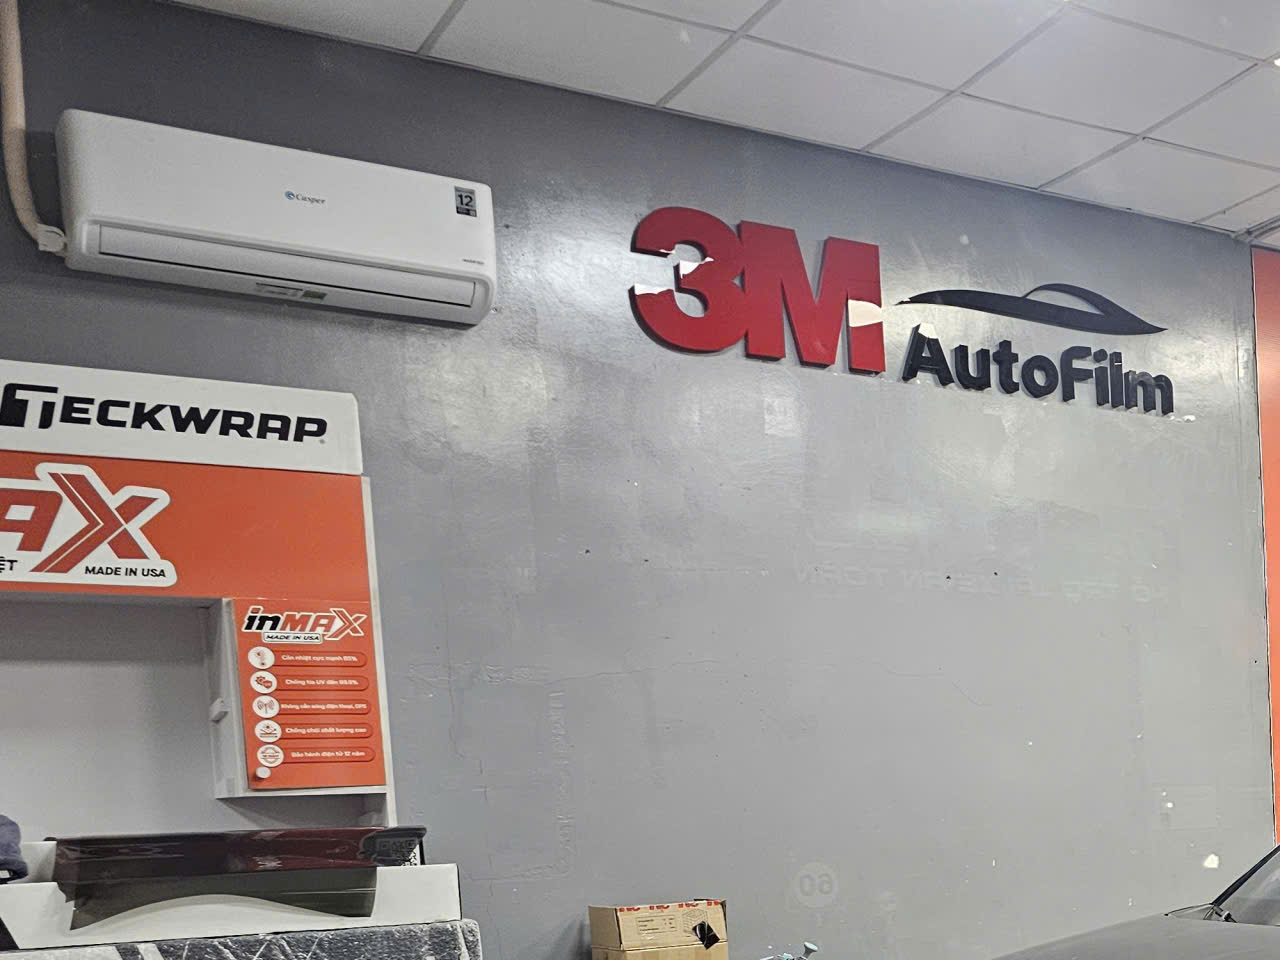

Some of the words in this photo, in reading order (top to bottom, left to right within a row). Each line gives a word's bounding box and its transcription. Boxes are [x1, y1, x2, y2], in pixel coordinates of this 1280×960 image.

[457, 193, 474, 208] 12
[630, 206, 887, 375] 3M
[900, 322, 1174, 416] AutoFilm
[0, 382, 328, 444] TECKWRAP
[85, 565, 122, 577] MADE
[125, 567, 138, 577] IN
[141, 568, 167, 579] USA
[304, 634, 321, 642] USA
